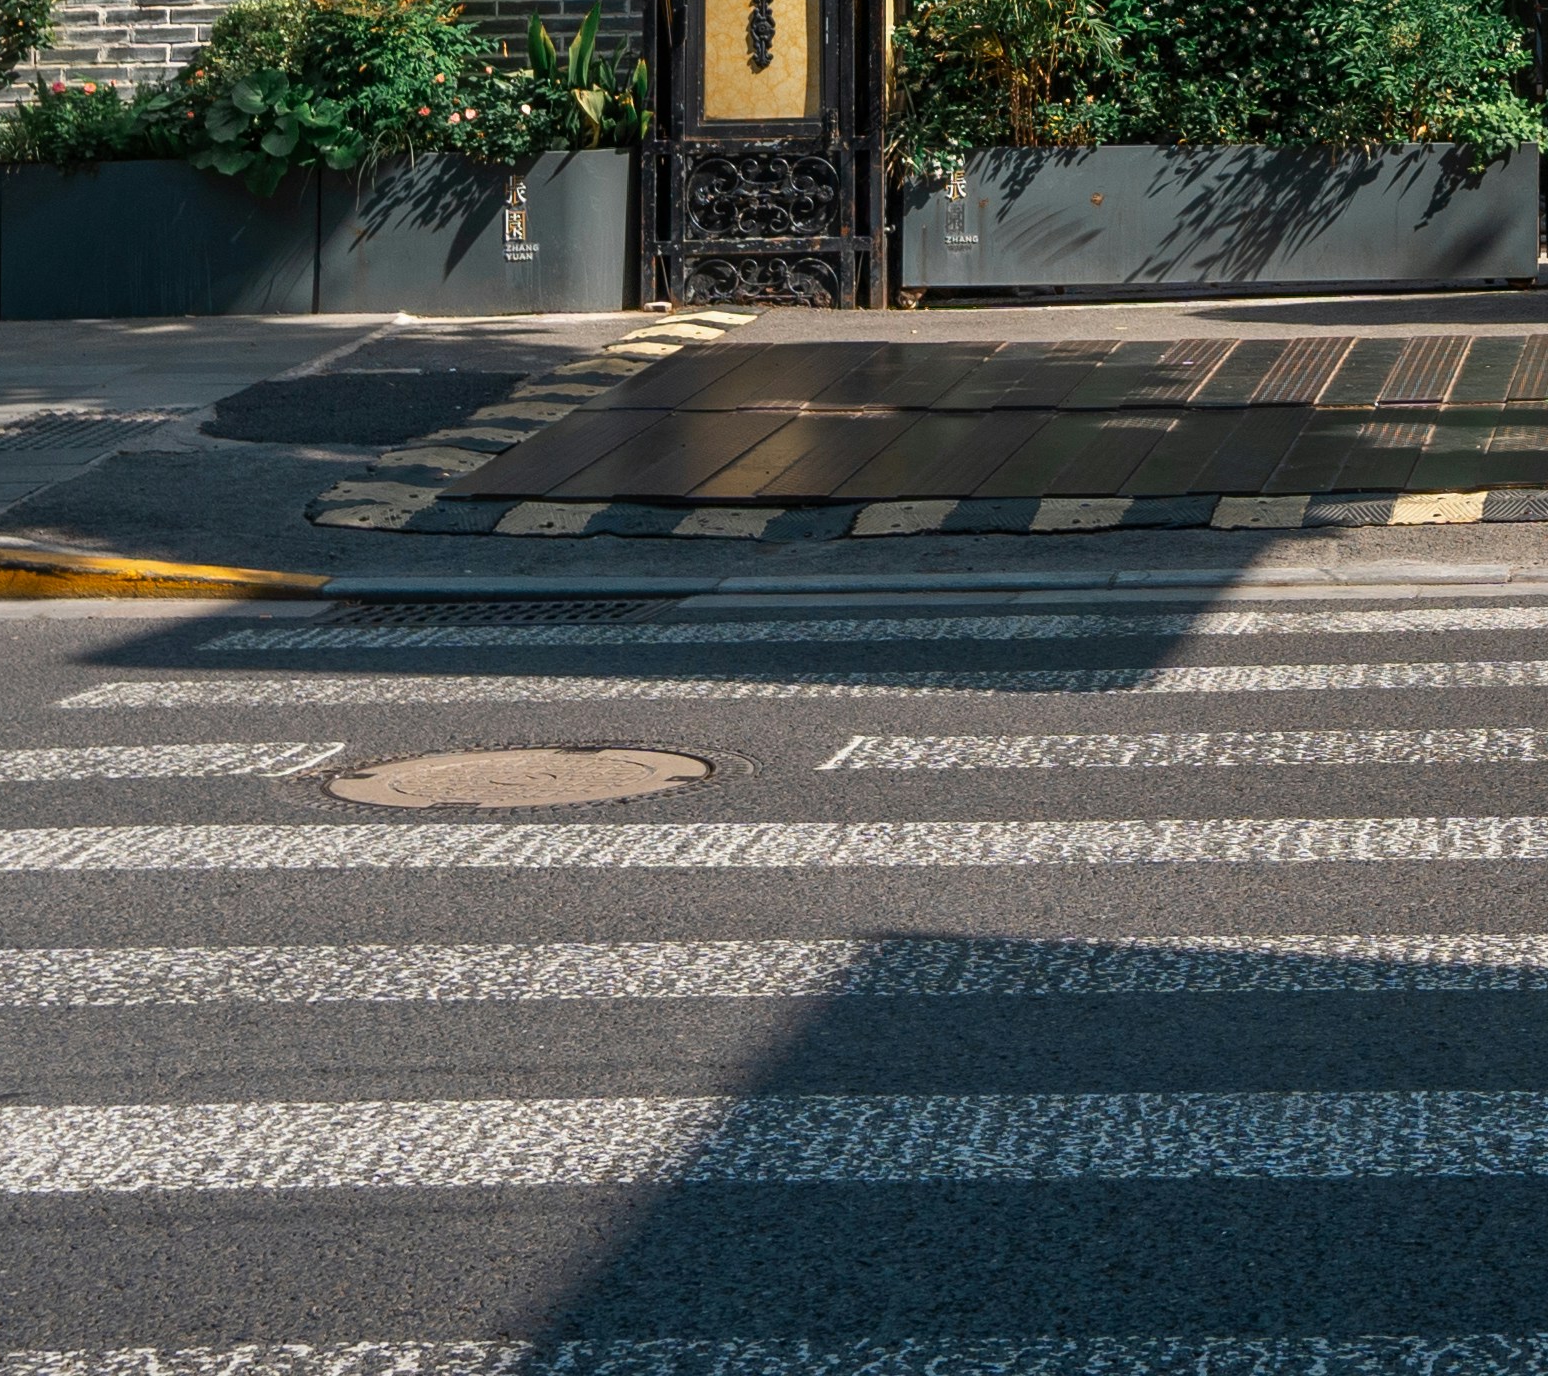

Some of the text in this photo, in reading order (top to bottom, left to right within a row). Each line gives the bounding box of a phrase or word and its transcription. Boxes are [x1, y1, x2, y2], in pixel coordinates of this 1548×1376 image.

[946, 235, 979, 243] ZHANG
[505, 243, 540, 252] ZHANG
[505, 253, 533, 261] YUAN
